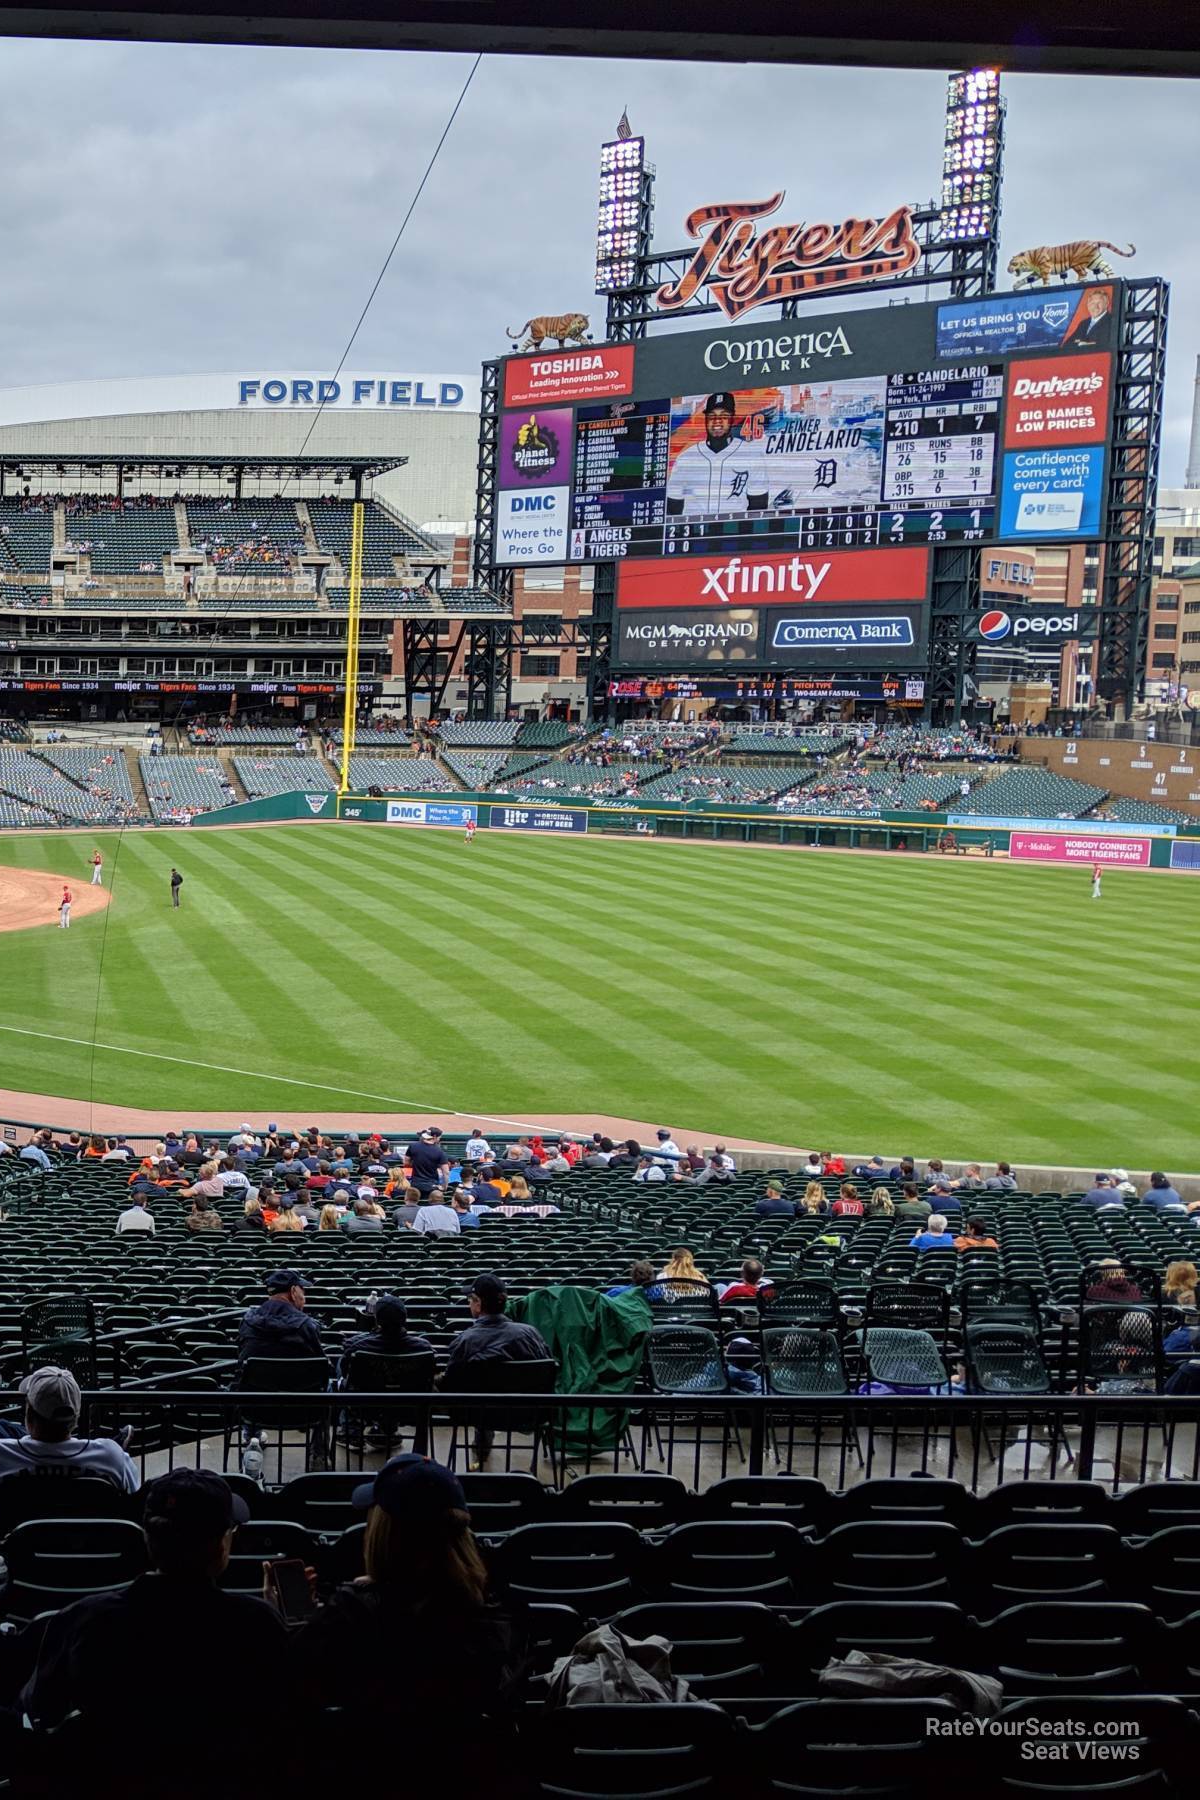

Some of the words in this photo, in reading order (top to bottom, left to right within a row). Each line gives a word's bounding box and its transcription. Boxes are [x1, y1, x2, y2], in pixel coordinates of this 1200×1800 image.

[656, 190, 921, 322] Tigers
[940, 319, 959, 330] LET
[962, 318, 977, 328] US
[979, 313, 1014, 326] BRING
[1017, 310, 1040, 321] YOU
[953, 331, 983, 340] OFFICIAL
[985, 327, 1015, 336] REALTOR
[530, 355, 604, 376] TOSHIBA
[743, 356, 811, 376] PARK
[529, 378, 560, 388] Leading
[561, 372, 603, 384] Innovation
[891, 374, 904, 386] 46
[917, 365, 989, 384] CANDELARIO
[888, 387, 906, 396] Born:
[908, 384, 946, 394] 11-24-1993
[1013, 372, 1104, 396] Dunham's
[238, 379, 341, 404] FORD
[352, 380, 464, 406] FIELD
[898, 410, 913, 418] AVG
[936, 407, 947, 416] HR
[973, 404, 987, 412] RBI
[1020, 410, 1043, 421] BIG
[1046, 406, 1093, 419] NAMES
[588, 427, 628, 437] CASTELLANOS
[740, 414, 765, 441] 46
[781, 418, 821, 434] JEIMER
[890, 421, 919, 437] .210
[974, 415, 984, 430] 7
[1016, 421, 1044, 433] LOW
[1048, 418, 1096, 431] PRICES
[587, 444, 616, 453] GOODRUM
[588, 437, 615, 445] CABRERA
[766, 428, 862, 454] CANDELARIO
[896, 441, 915, 452] HITS
[929, 439, 952, 449] RUNS
[971, 437, 982, 446] BB
[515, 447, 548, 461] planet
[587, 451, 620, 461] RODRIGUEZ
[898, 453, 911, 466] 26
[933, 451, 946, 463] 15
[970, 449, 982, 461] 18
[1015, 452, 1090, 466] Confidence
[519, 457, 555, 468] fitness
[587, 460, 609, 468] CASTRO
[895, 471, 912, 481] OBP
[933, 469, 944, 479] 2B
[969, 467, 981, 476] 3B
[1014, 467, 1057, 479] comes
[1060, 463, 1090, 476] with
[586, 484, 603, 492] JONES
[892, 483, 914, 497] .315
[935, 481, 942, 494] 6
[1013, 480, 1050, 493] every
[1053, 475, 1085, 488] card.
[511, 495, 556, 512] DMC
[891, 513, 904, 532] 2
[929, 511, 943, 530] 2
[971, 509, 980, 528] 1
[502, 529, 539, 540] Where
[543, 525, 563, 537] the
[589, 528, 632, 542] ANGELS
[669, 526, 676, 537] 2
[683, 525, 690, 536] 3
[928, 531, 946, 541] 2:53
[963, 530, 984, 539] 70°F
[509, 544, 533, 555] Pros
[538, 543, 554, 554] Go
[589, 544, 628, 557] TIGERS
[669, 541, 675, 552] 0
[683, 540, 689, 552] 0
[701, 557, 831, 602] xfinity
[626, 624, 669, 639] MGM
[691, 622, 754, 638] GRAND
[860, 622, 902, 638] Bank
[1013, 613, 1079, 636] pepsi
[648, 638, 729, 648] DETROIT
[248, 682, 278, 694] meijer
[883, 689, 896, 697] 94
[1066, 743, 1077, 754] 23
[1155, 773, 1166, 785] 47
[344, 808, 362, 817] 345'
[391, 806, 421, 819] DMC
[503, 809, 529, 826] Lite
[542, 813, 574, 821] ORIGINAL
[776, 805, 881, 818] MotorCityCasino.com
[555, 820, 573, 828] BEER
[1065, 841, 1099, 850] NOBODY
[1099, 842, 1143, 852] CONNECTS
[1066, 849, 1090, 858] MORE
[1091, 850, 1119, 859] TIGERS
[1120, 852, 1141, 860] FANS
